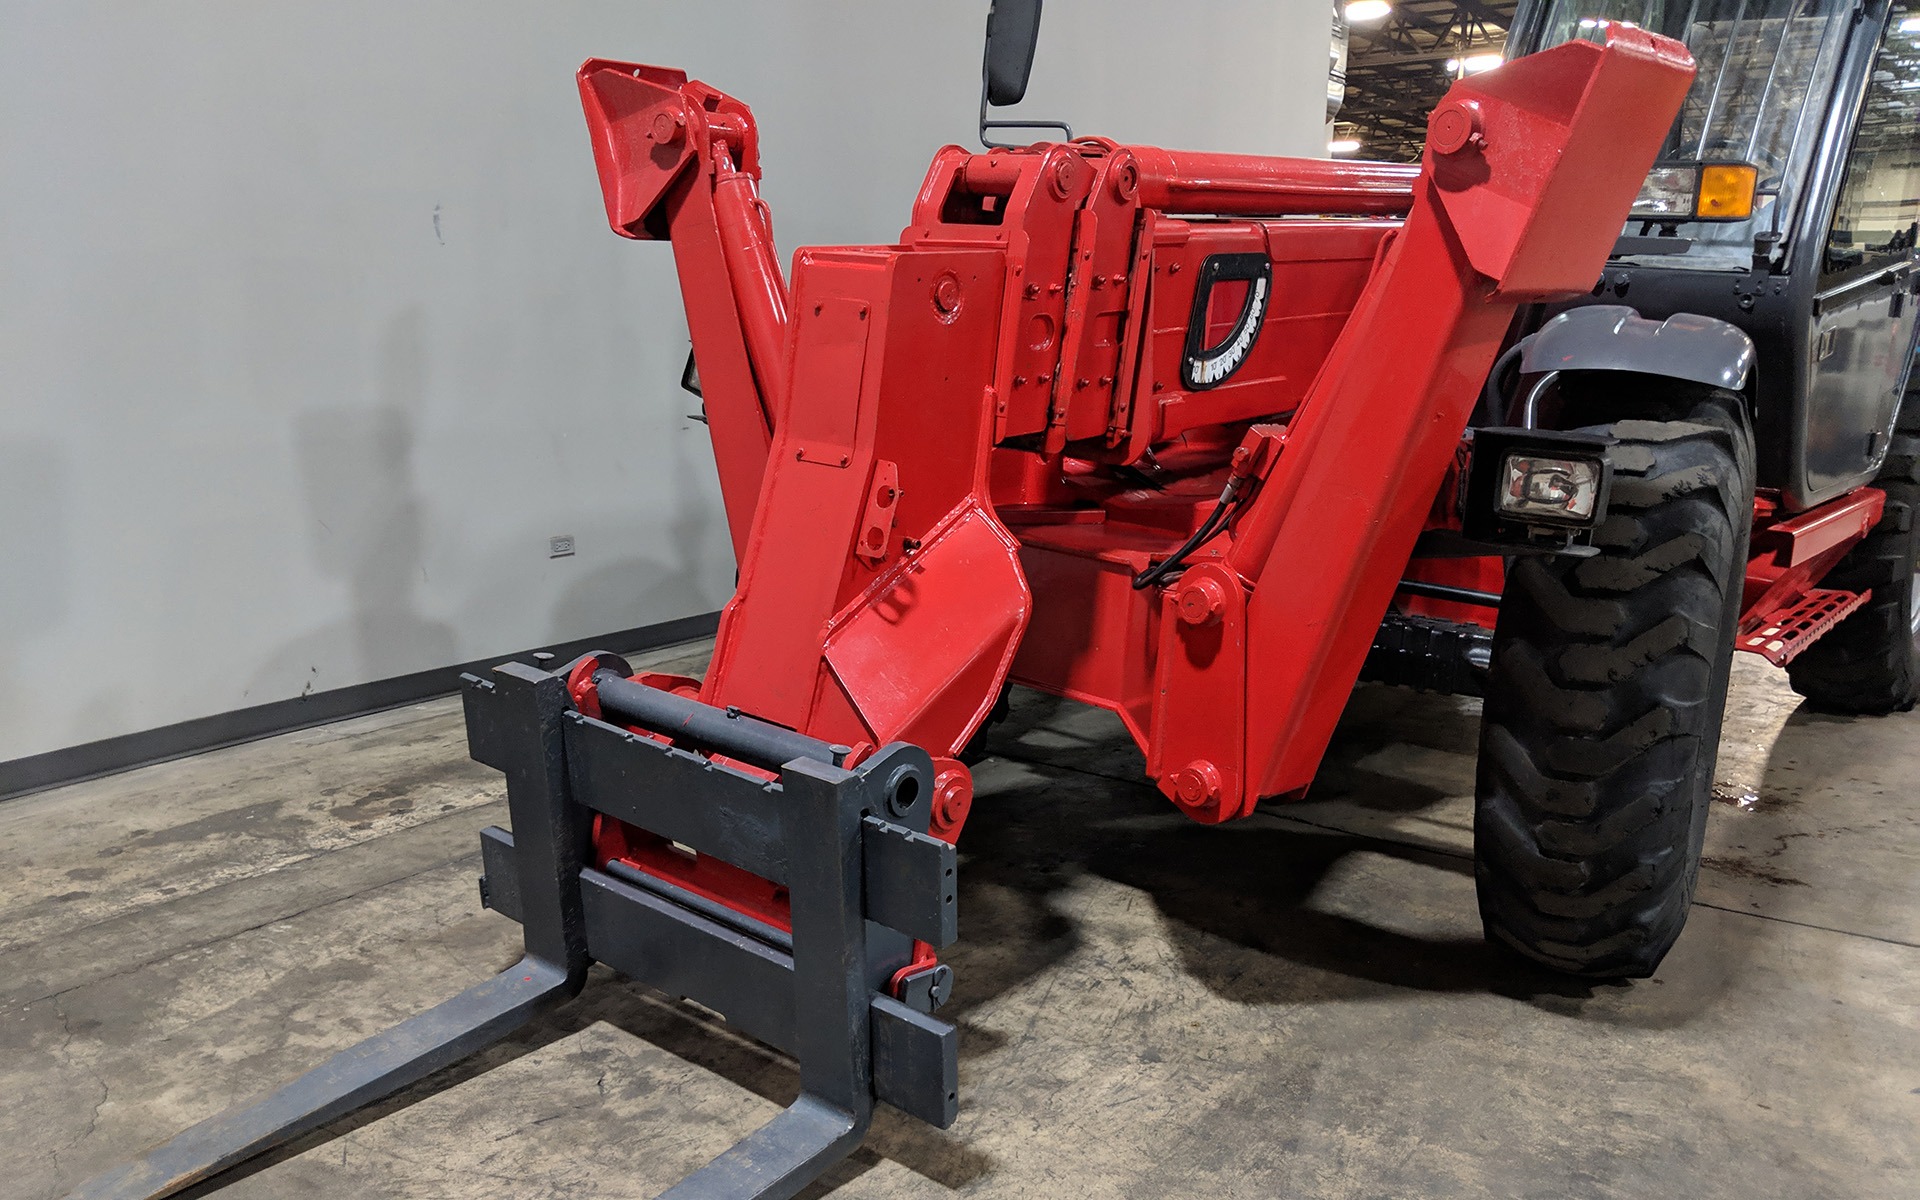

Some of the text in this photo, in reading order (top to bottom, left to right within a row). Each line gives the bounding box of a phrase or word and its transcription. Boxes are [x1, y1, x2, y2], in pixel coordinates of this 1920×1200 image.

[1210, 361, 1218, 371] 10
[1220, 355, 1227, 366] 20
[1229, 347, 1236, 358] 30
[1237, 335, 1243, 346] 40
